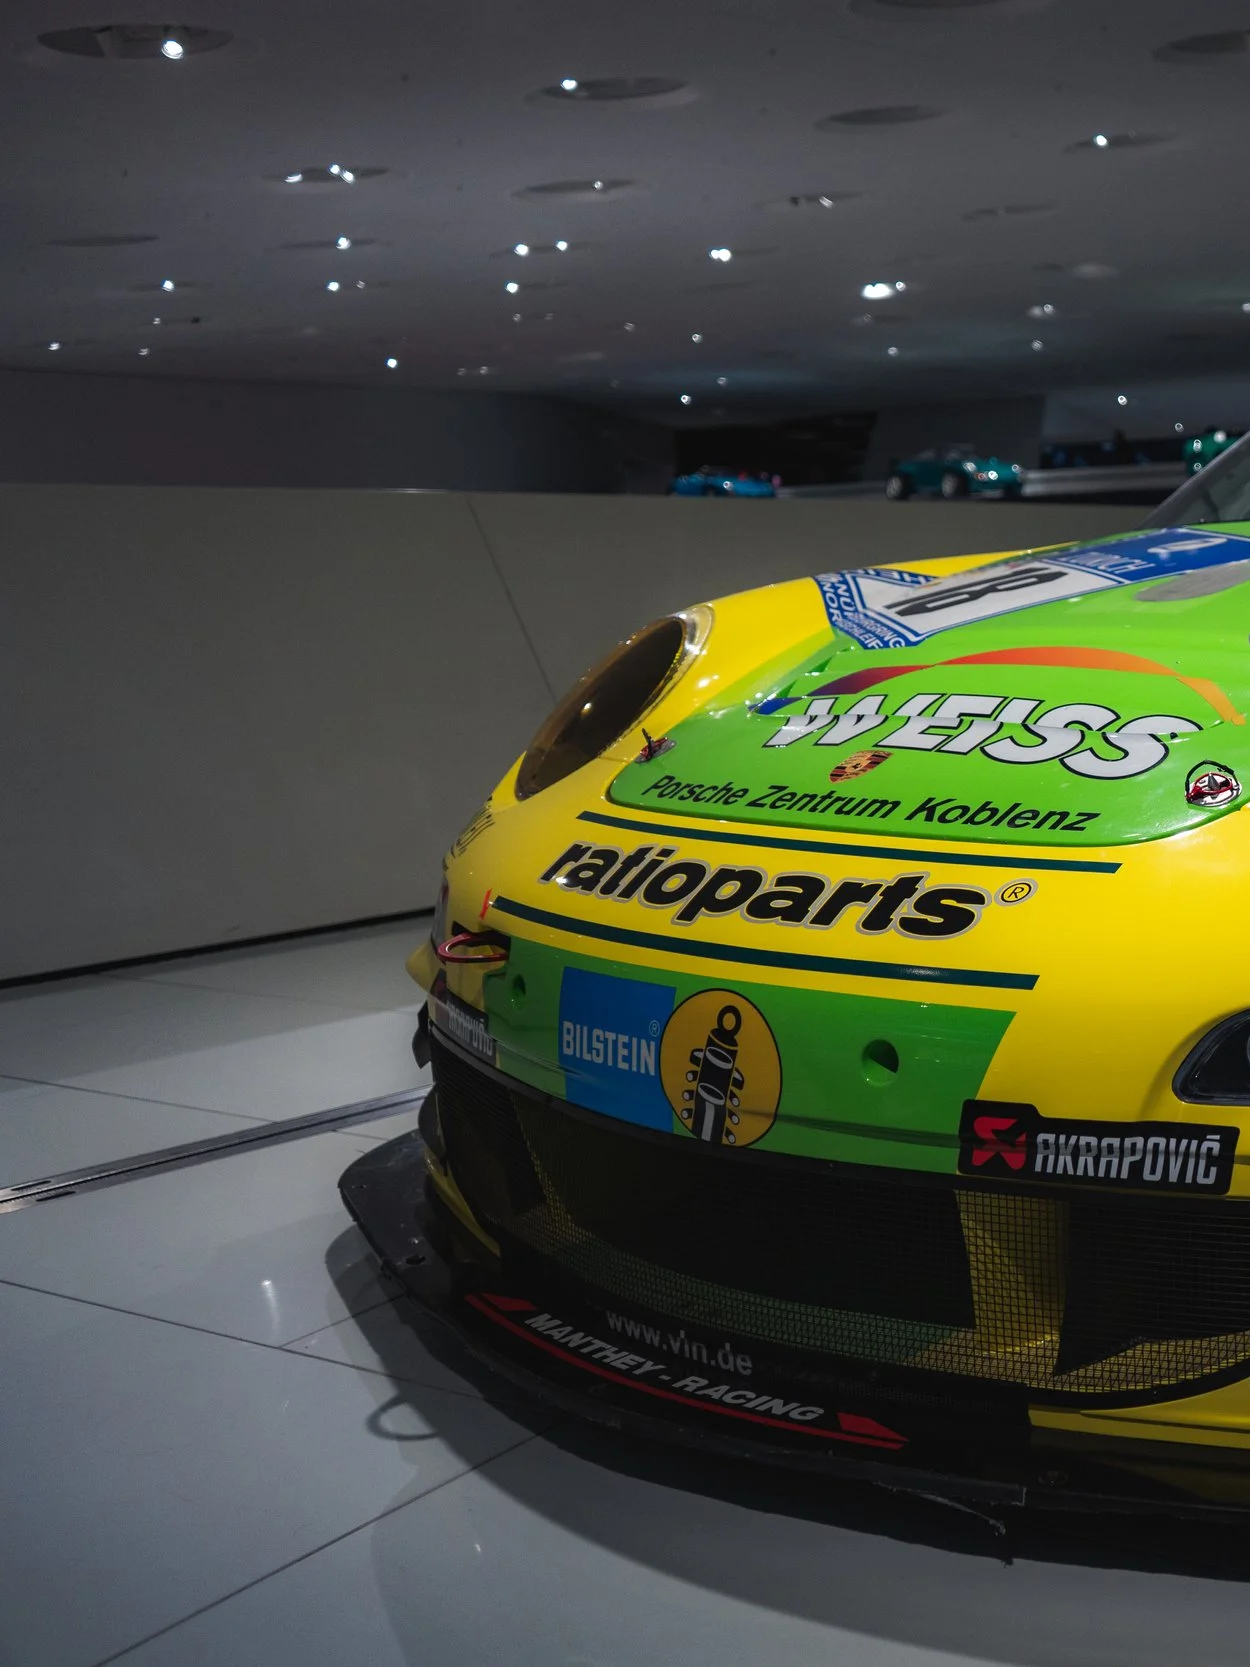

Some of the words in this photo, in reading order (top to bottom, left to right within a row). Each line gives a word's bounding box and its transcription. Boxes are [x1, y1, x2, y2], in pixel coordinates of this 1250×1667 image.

[761, 693, 1204, 780] WEISS
[641, 775, 749, 806] Porsche
[746, 785, 901, 820] Zentrum
[904, 797, 1101, 832] Koblenz
[540, 843, 992, 940] ratioparts
[563, 1020, 656, 1076] BILSTEIN
[524, 1313, 665, 1376] MANTHEY
[672, 1376, 825, 1421] RACING
